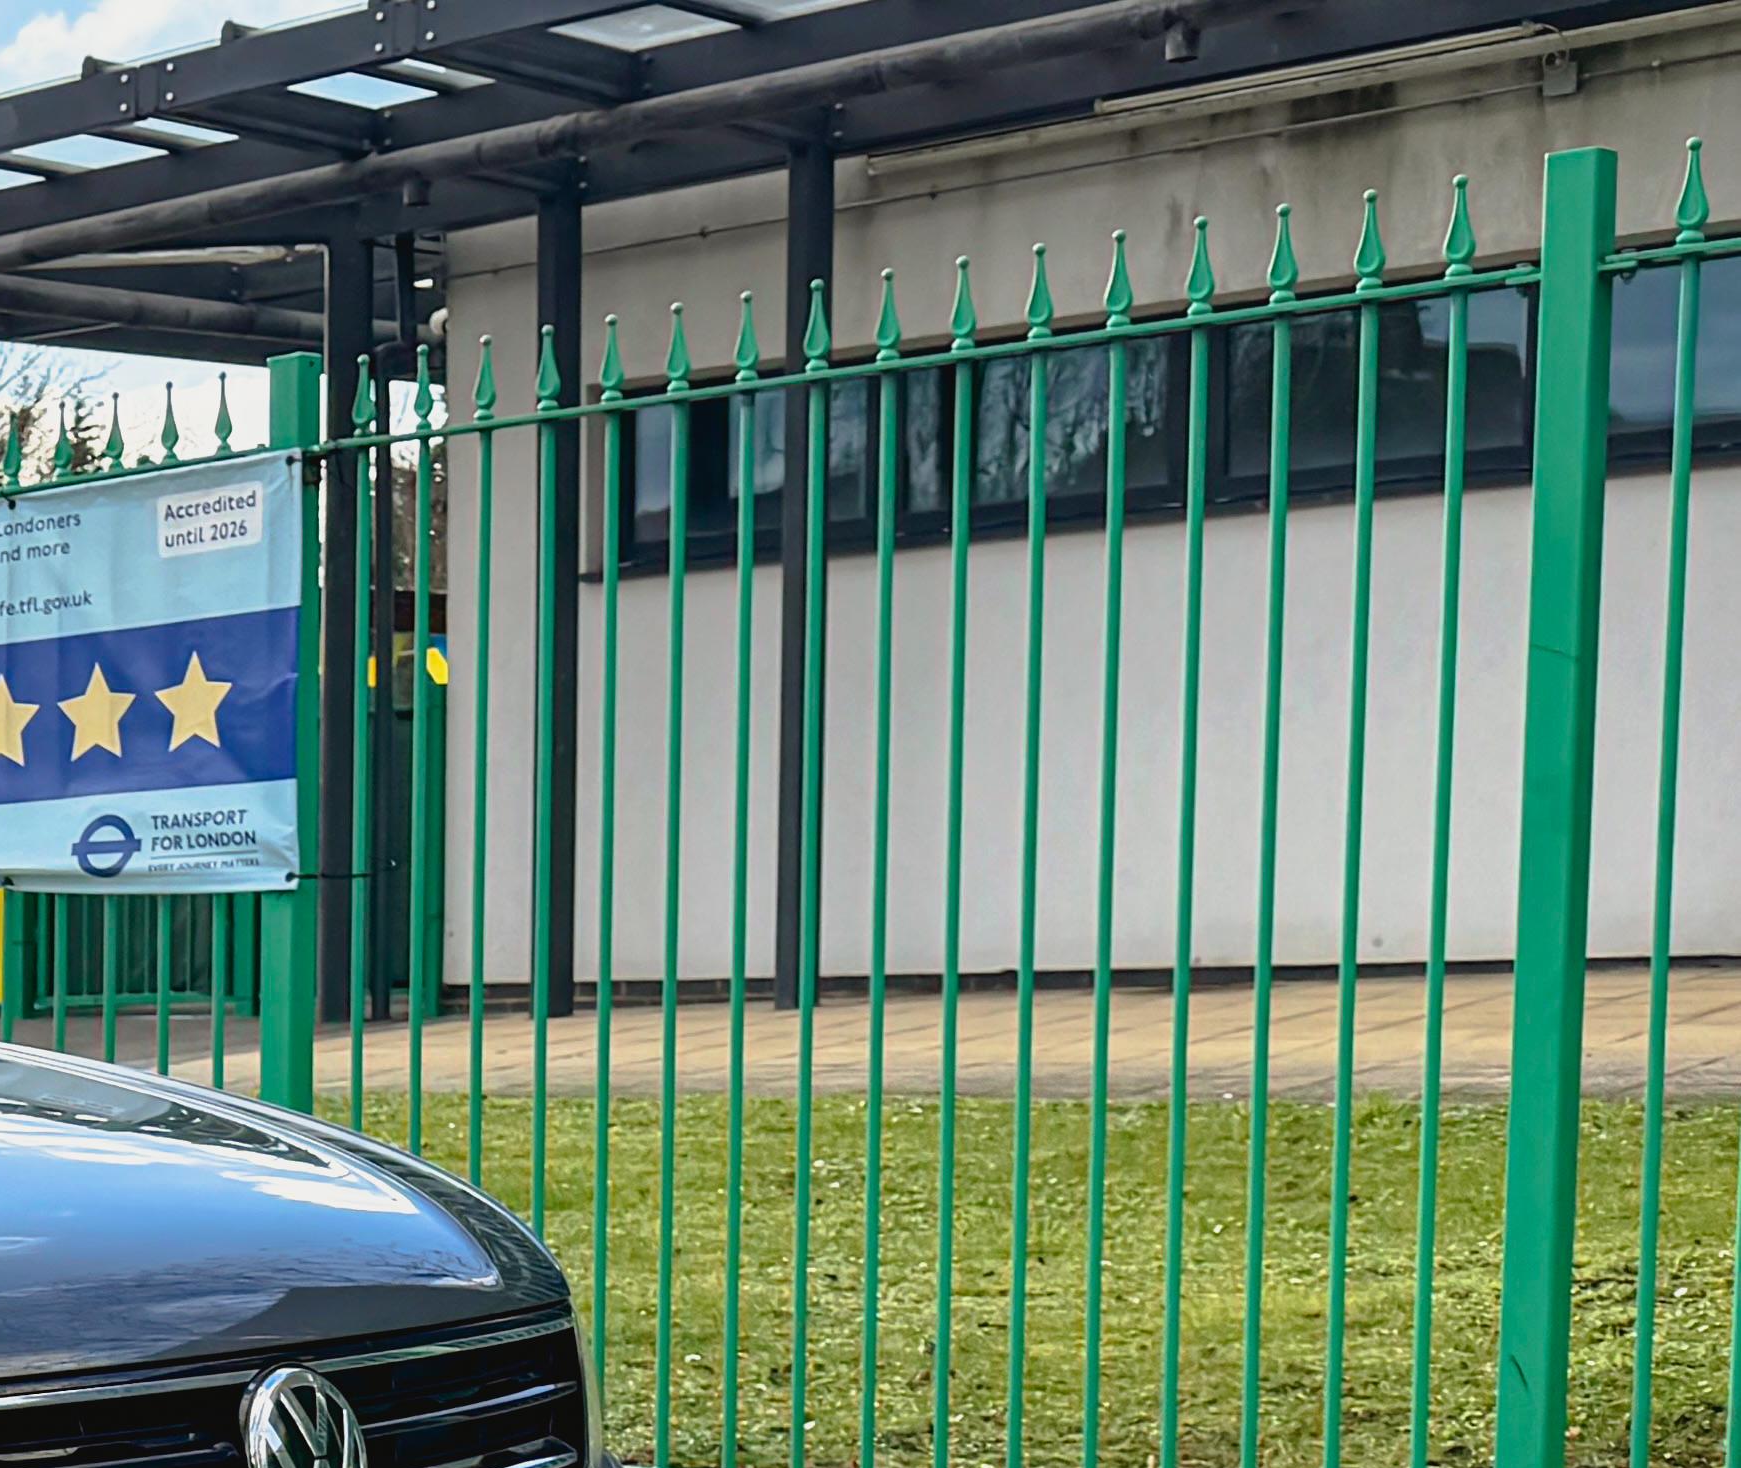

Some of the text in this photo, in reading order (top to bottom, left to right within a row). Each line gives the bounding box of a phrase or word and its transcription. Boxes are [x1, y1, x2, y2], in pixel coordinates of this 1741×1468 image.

[164, 490, 257, 521] Accredited
[165, 520, 247, 548] until 2026
[27, 541, 71, 559] more
[151, 809, 248, 830] TRANSPORT
[151, 830, 257, 852] FOR LONDON
